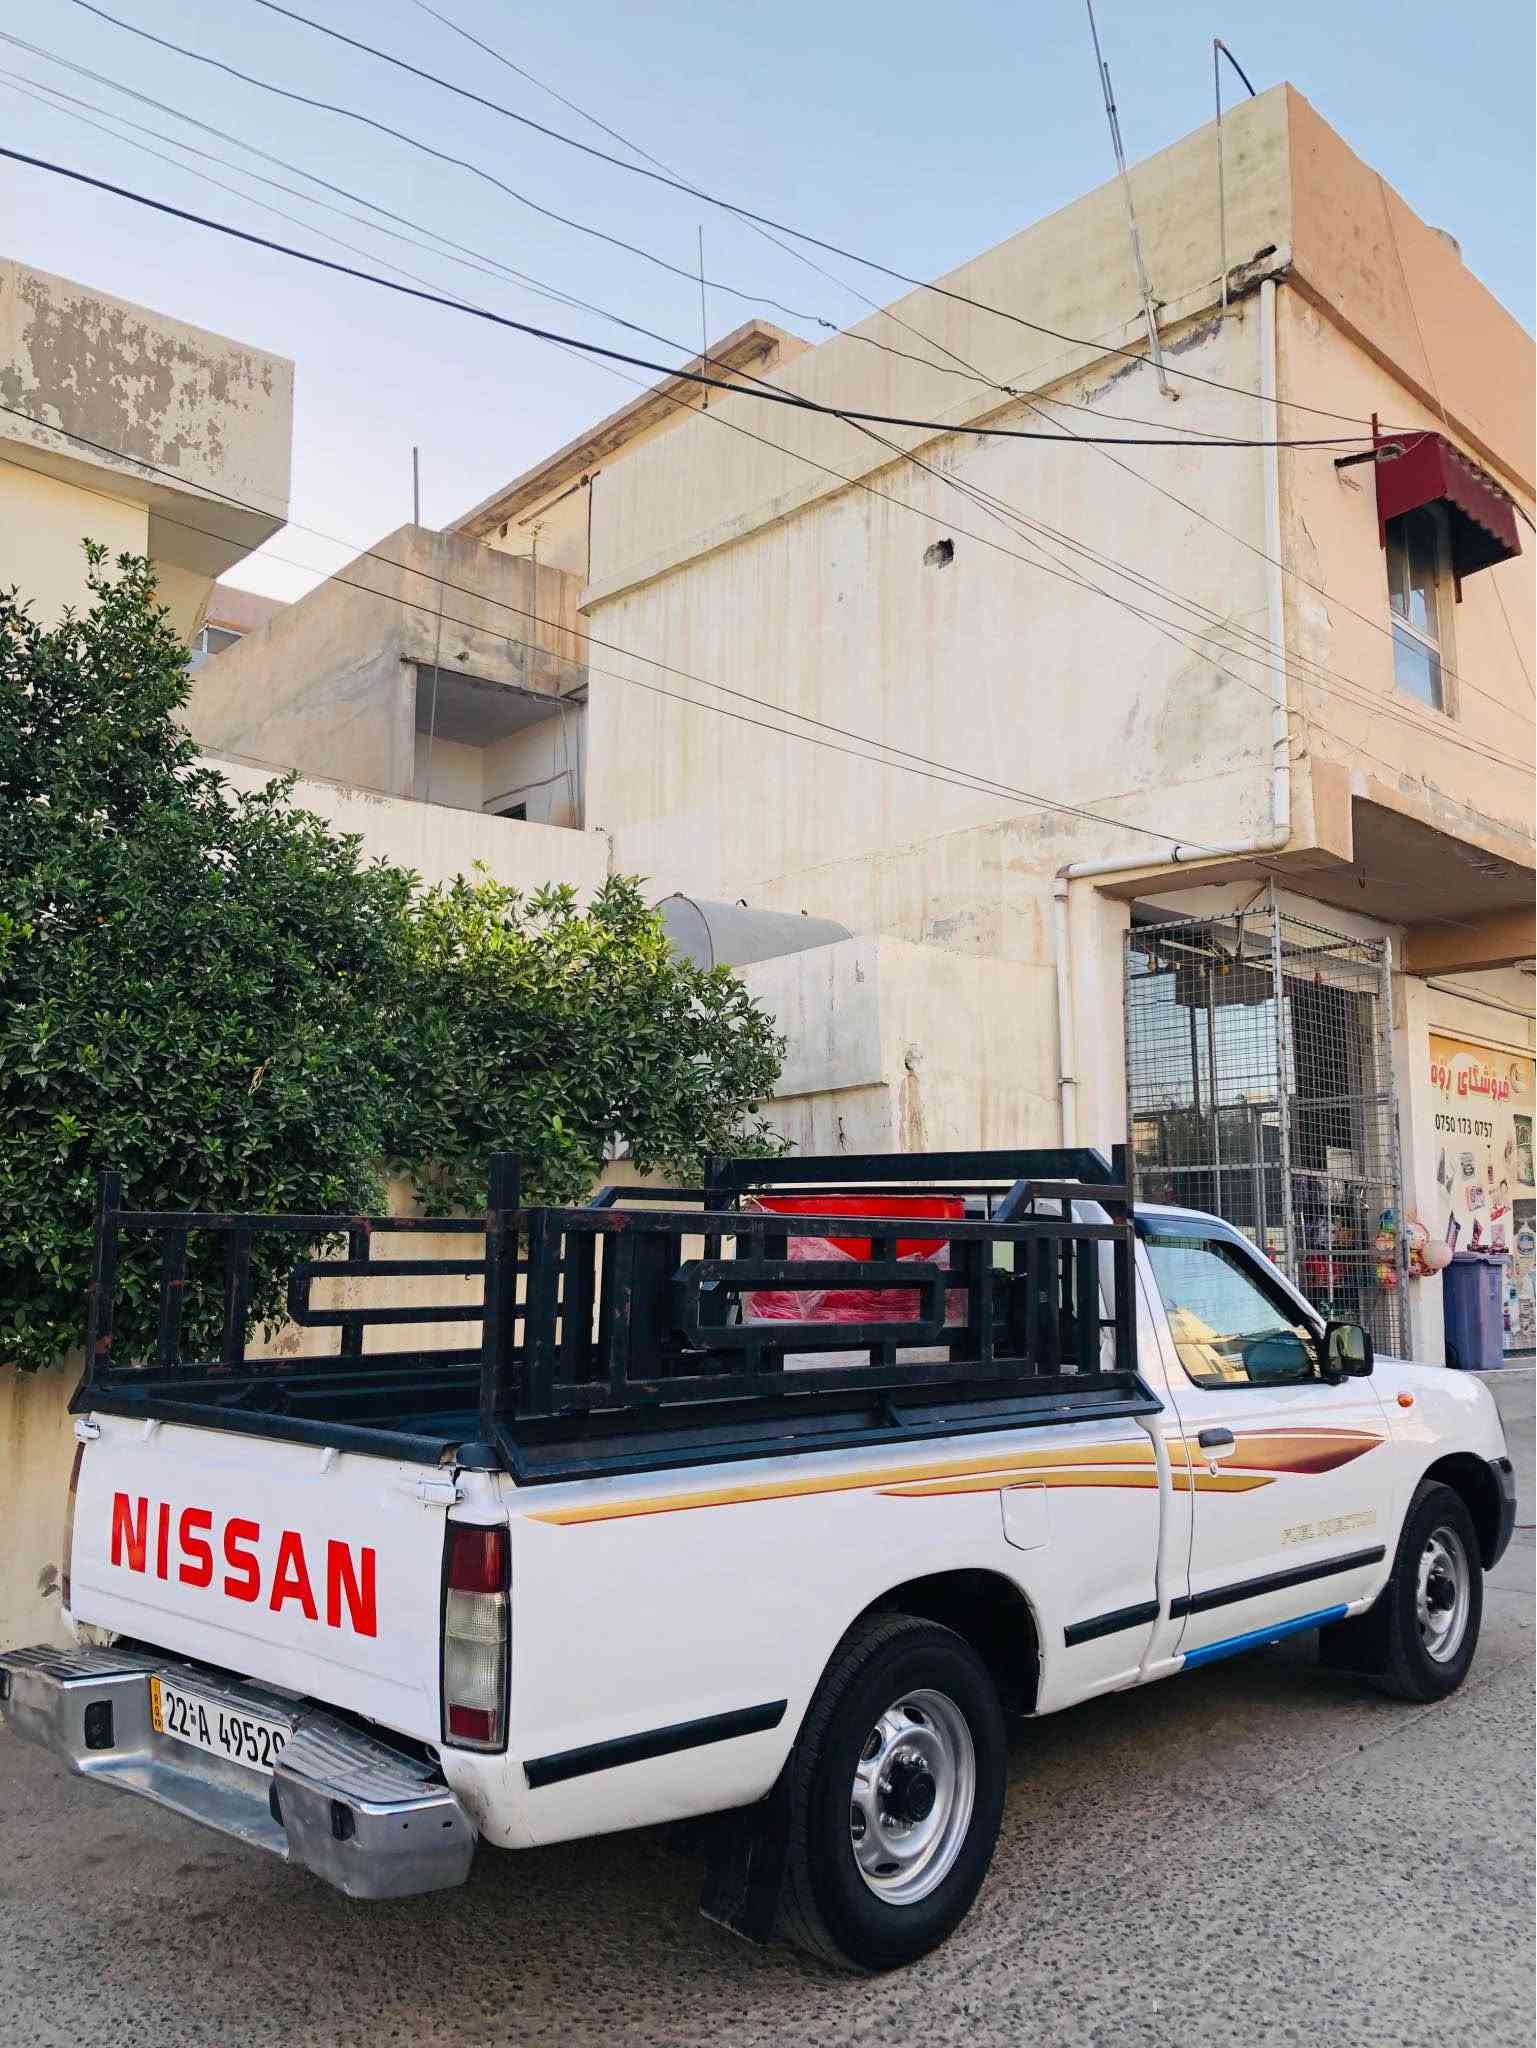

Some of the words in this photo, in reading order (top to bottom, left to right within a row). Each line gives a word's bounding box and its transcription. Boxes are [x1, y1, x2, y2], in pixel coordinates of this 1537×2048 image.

[1435, 1113, 1455, 1133] 0750
[1457, 1117, 1472, 1135] 173
[1474, 1119, 1493, 1138] 0757
[111, 1492, 377, 1638] NISSAN
[166, 1692, 190, 1737] 22
[198, 1704, 212, 1745] A
